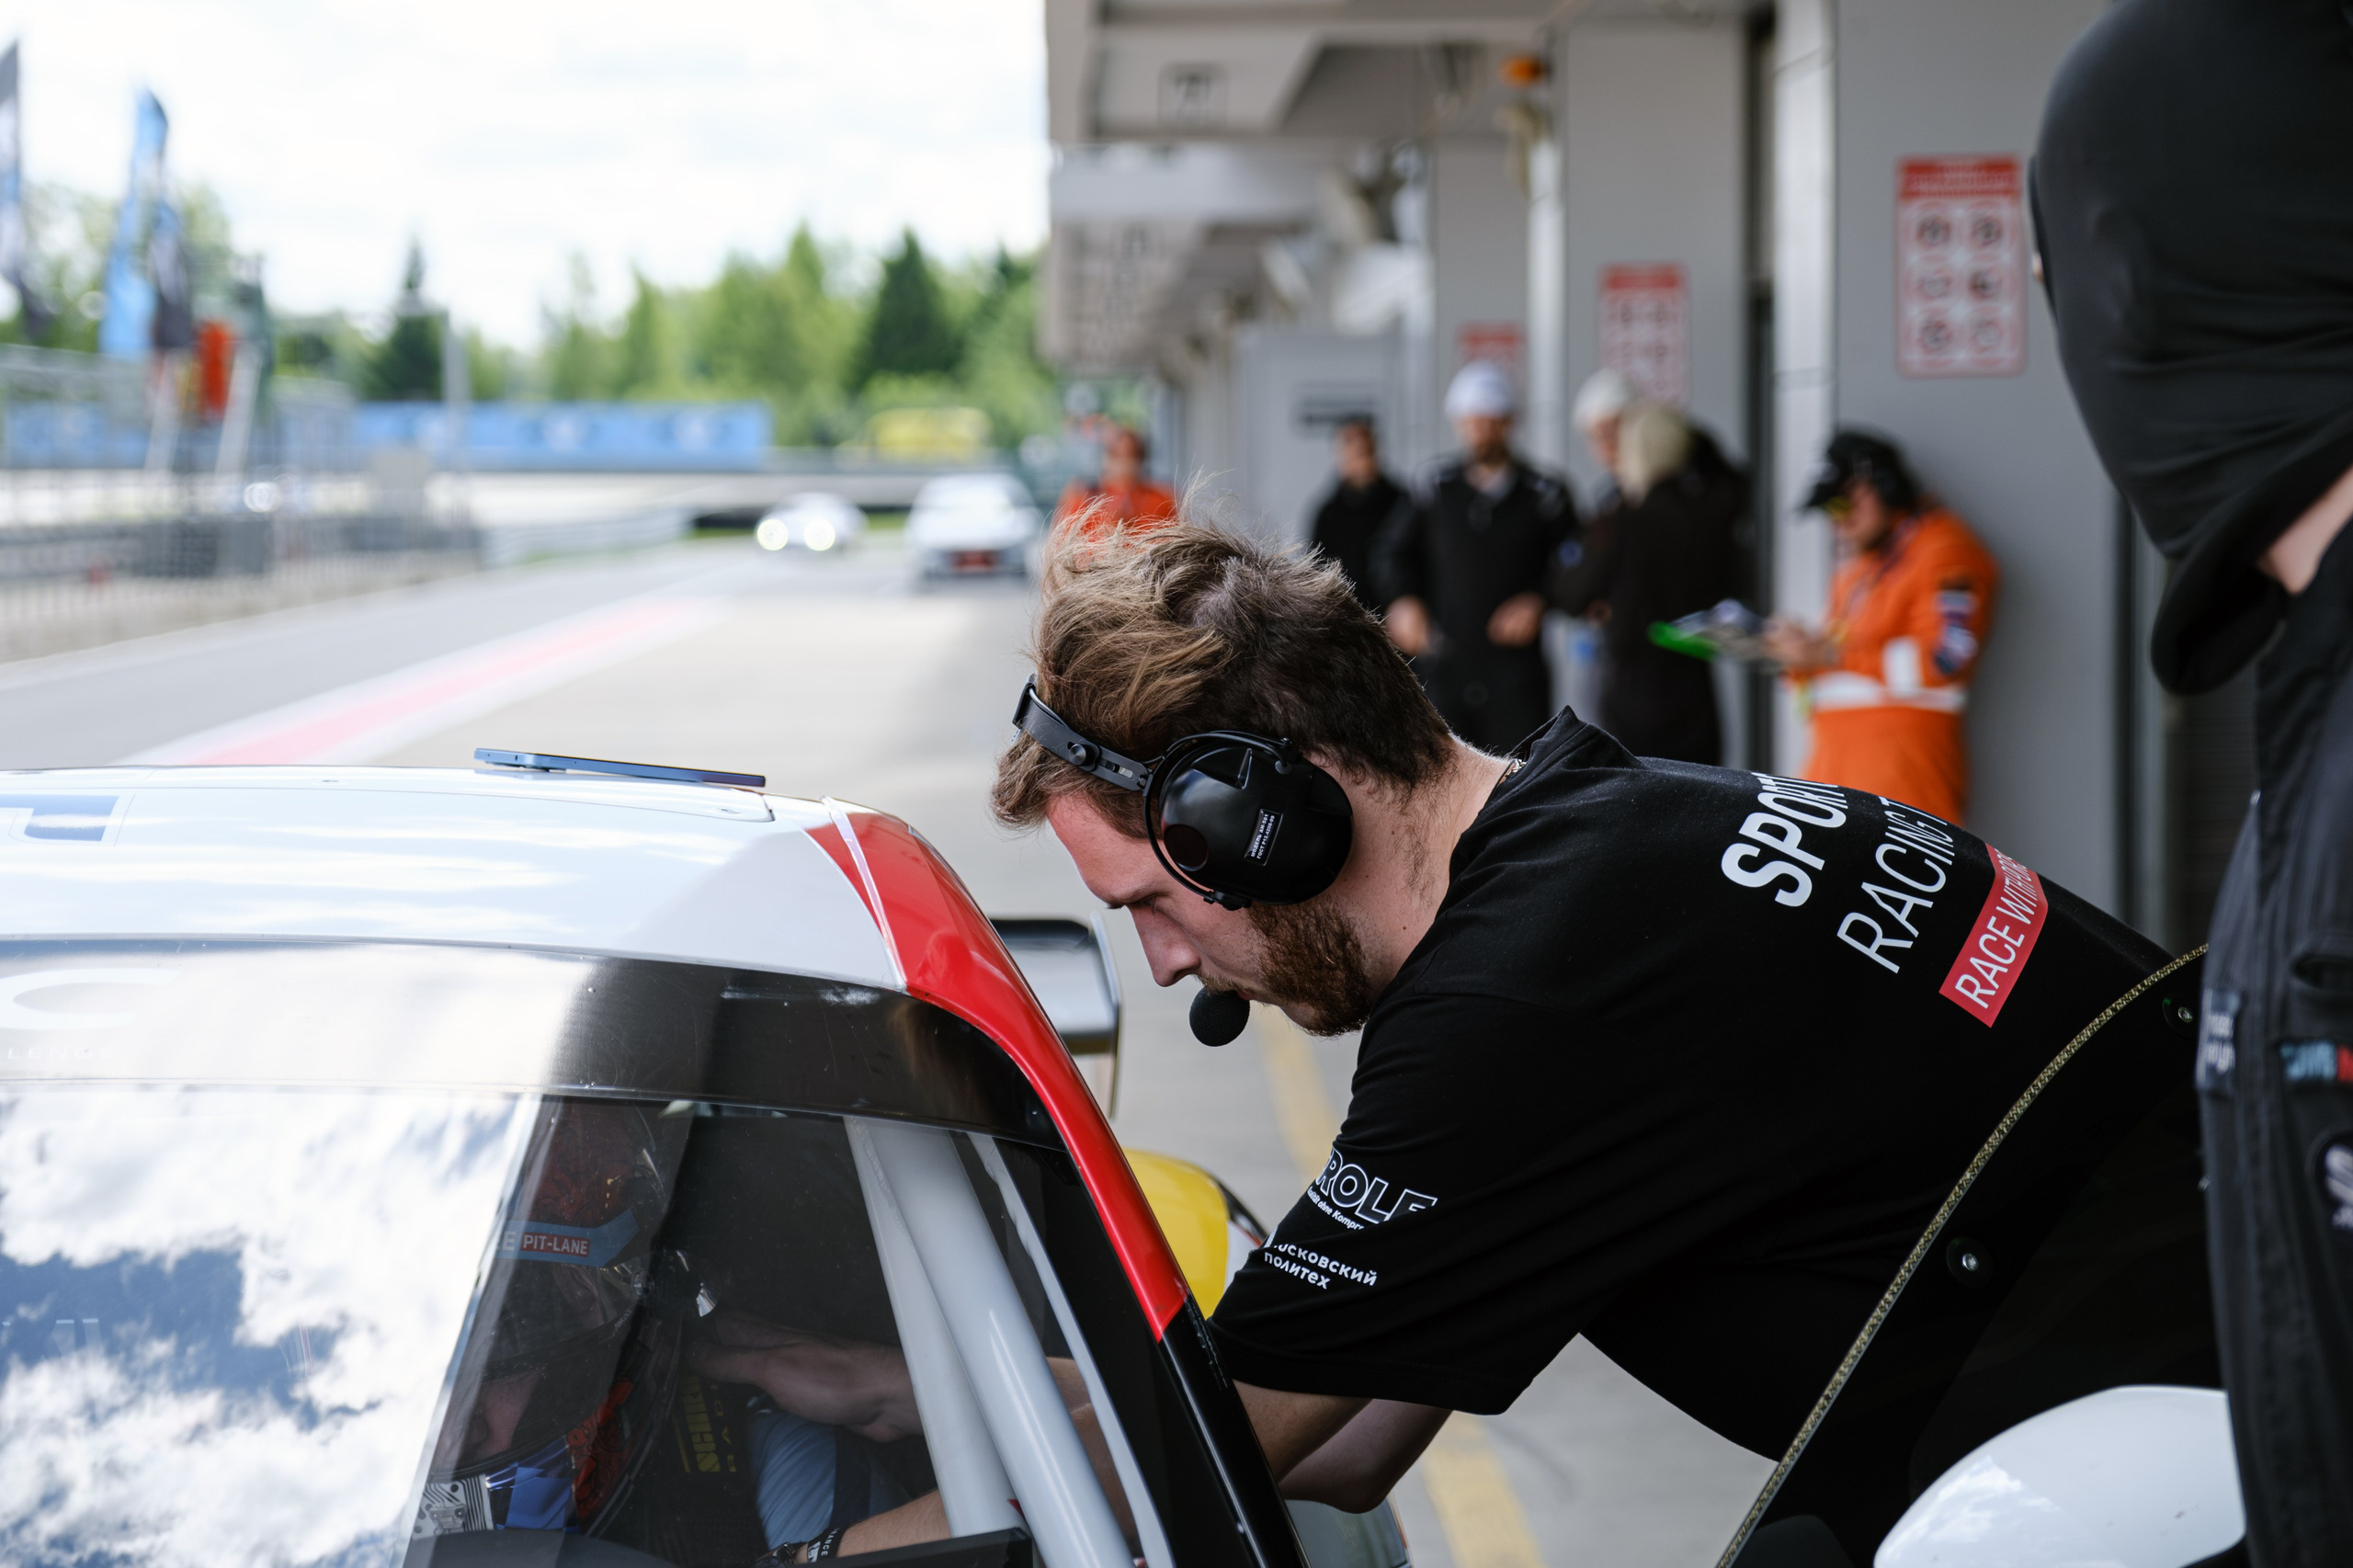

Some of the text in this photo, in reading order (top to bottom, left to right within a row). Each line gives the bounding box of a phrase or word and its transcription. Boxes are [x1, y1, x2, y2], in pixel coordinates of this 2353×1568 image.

[1256, 845, 1265, 859] ГОСТ
[1836, 811, 1955, 974] RACING
[1954, 915, 2025, 1009] RACE
[1995, 871, 2038, 925] WITH
[0, 1046, 115, 1061] LENGE
[1315, 1148, 1438, 1225] ROLF
[1317, 1200, 1334, 1216] ohne
[523, 1233, 589, 1256] PIT-LANE
[683, 1376, 722, 1472] SCHRO
[821, 1527, 840, 1557] RANCE
